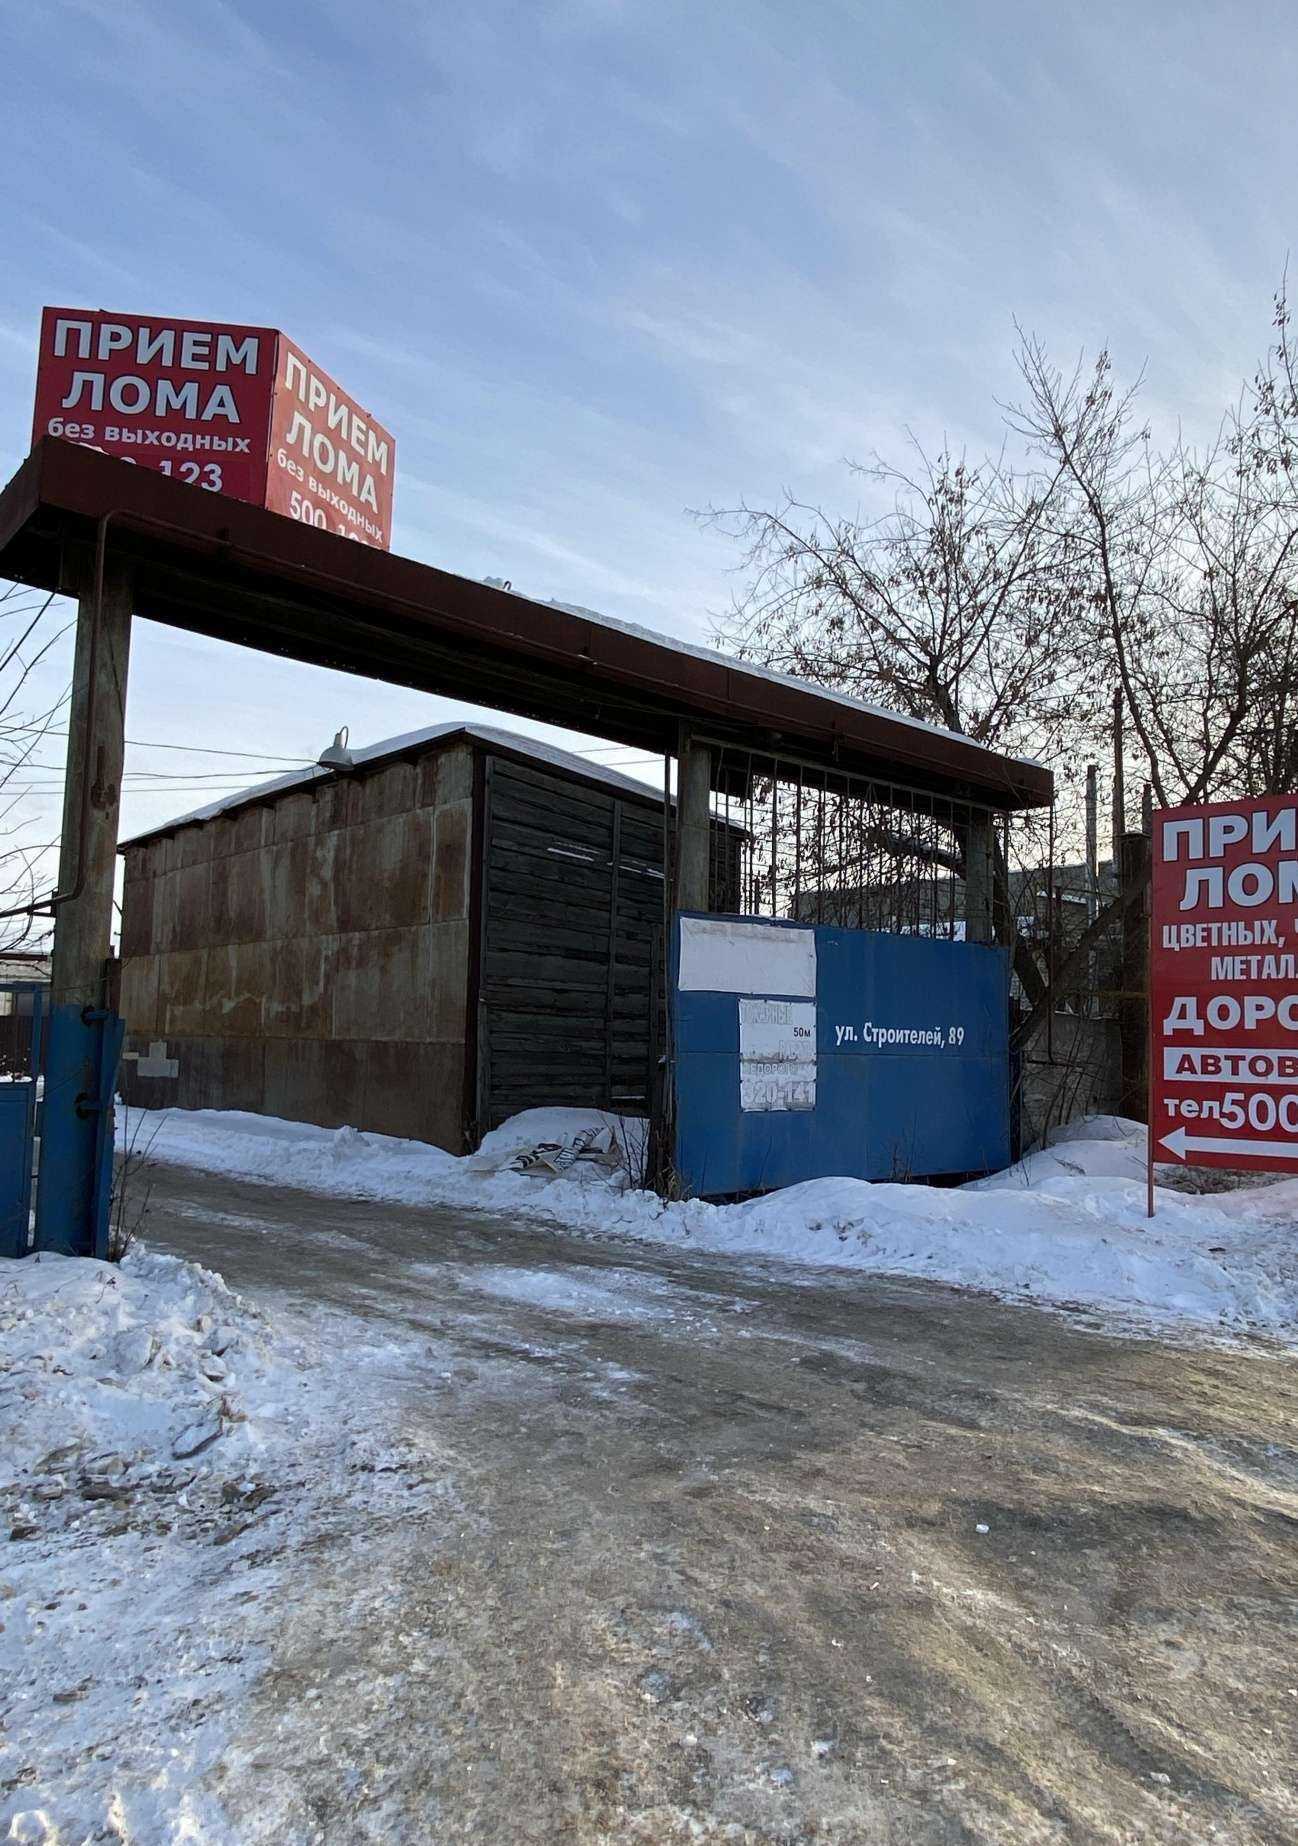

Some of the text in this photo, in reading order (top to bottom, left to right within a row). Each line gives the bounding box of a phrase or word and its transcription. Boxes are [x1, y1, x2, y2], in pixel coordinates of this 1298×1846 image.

[53, 318, 260, 376] ПРИЕМ
[61, 371, 241, 424] ЛОМА
[284, 352, 389, 476] ПРИЕМ
[47, 417, 251, 454] без выходных
[286, 411, 380, 514] ЛОМА
[277, 448, 305, 482] без
[308, 475, 384, 544] выходных
[1162, 919, 1285, 950] ЦВЕТНЫХ,
[835, 1021, 965, 1049] ул. Строителей, 89
